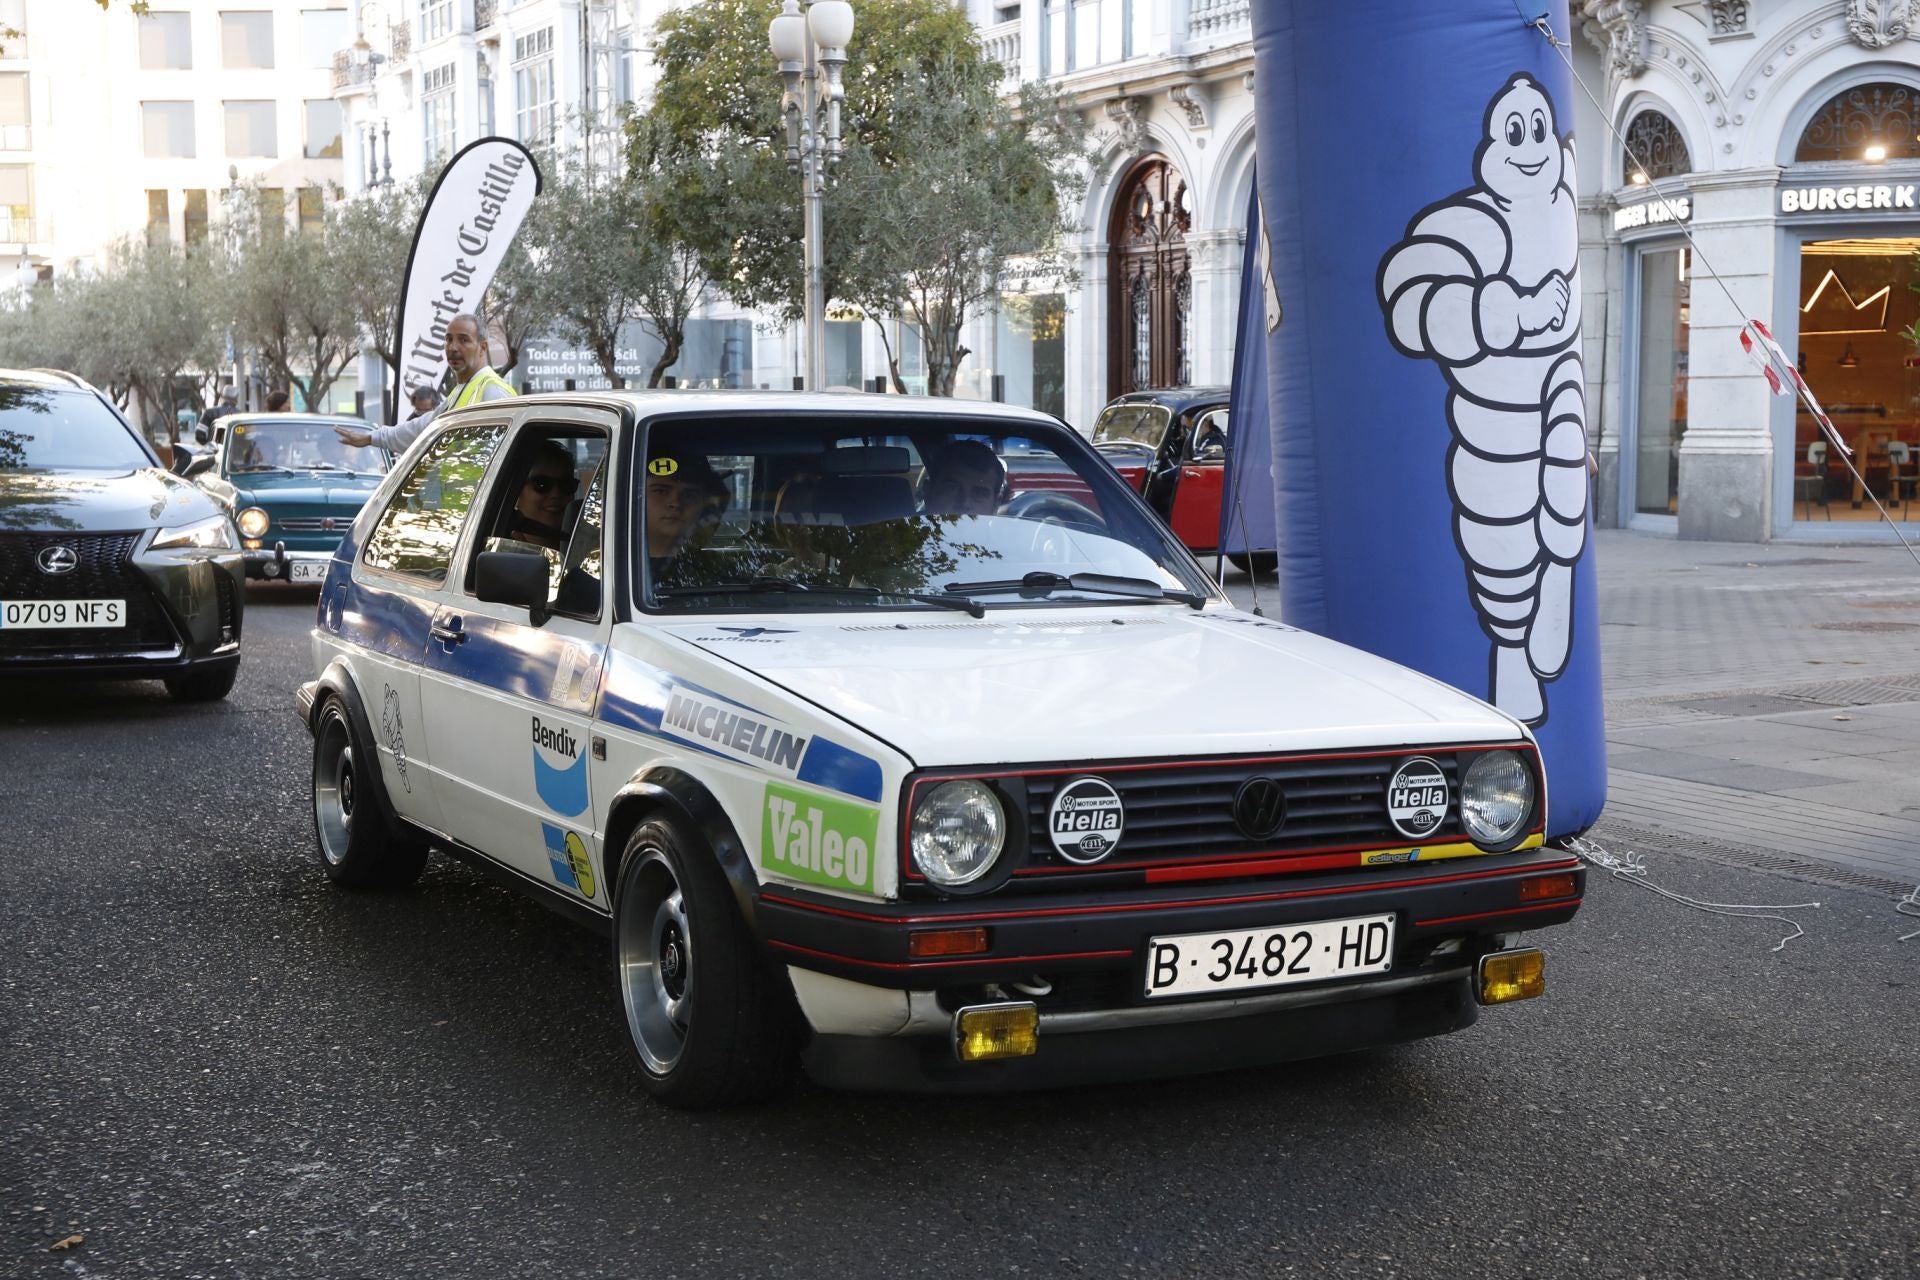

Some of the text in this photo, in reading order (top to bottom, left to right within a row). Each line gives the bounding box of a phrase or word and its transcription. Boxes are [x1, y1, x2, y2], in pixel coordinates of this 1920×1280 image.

[457, 153, 526, 256] Castilla
[1782, 185, 1920, 212] BURGER K
[441, 258, 476, 288] de
[410, 290, 464, 363] Norte
[527, 348, 558, 360] Todo
[562, 351, 577, 360] es
[527, 363, 576, 375] cuando
[543, 378, 586, 390] miso
[589, 377, 632, 390] idioa
[655, 460, 671, 473] H
[7, 603, 118, 623] 0709 NFS
[532, 716, 577, 759] Bendix
[665, 695, 806, 771] MICHELIN
[1427, 776, 1443, 784] SPORT
[1393, 787, 1444, 808] Hella
[1056, 810, 1118, 832] Hella
[768, 795, 868, 887] Valeo
[1368, 852, 1410, 864] oettinger
